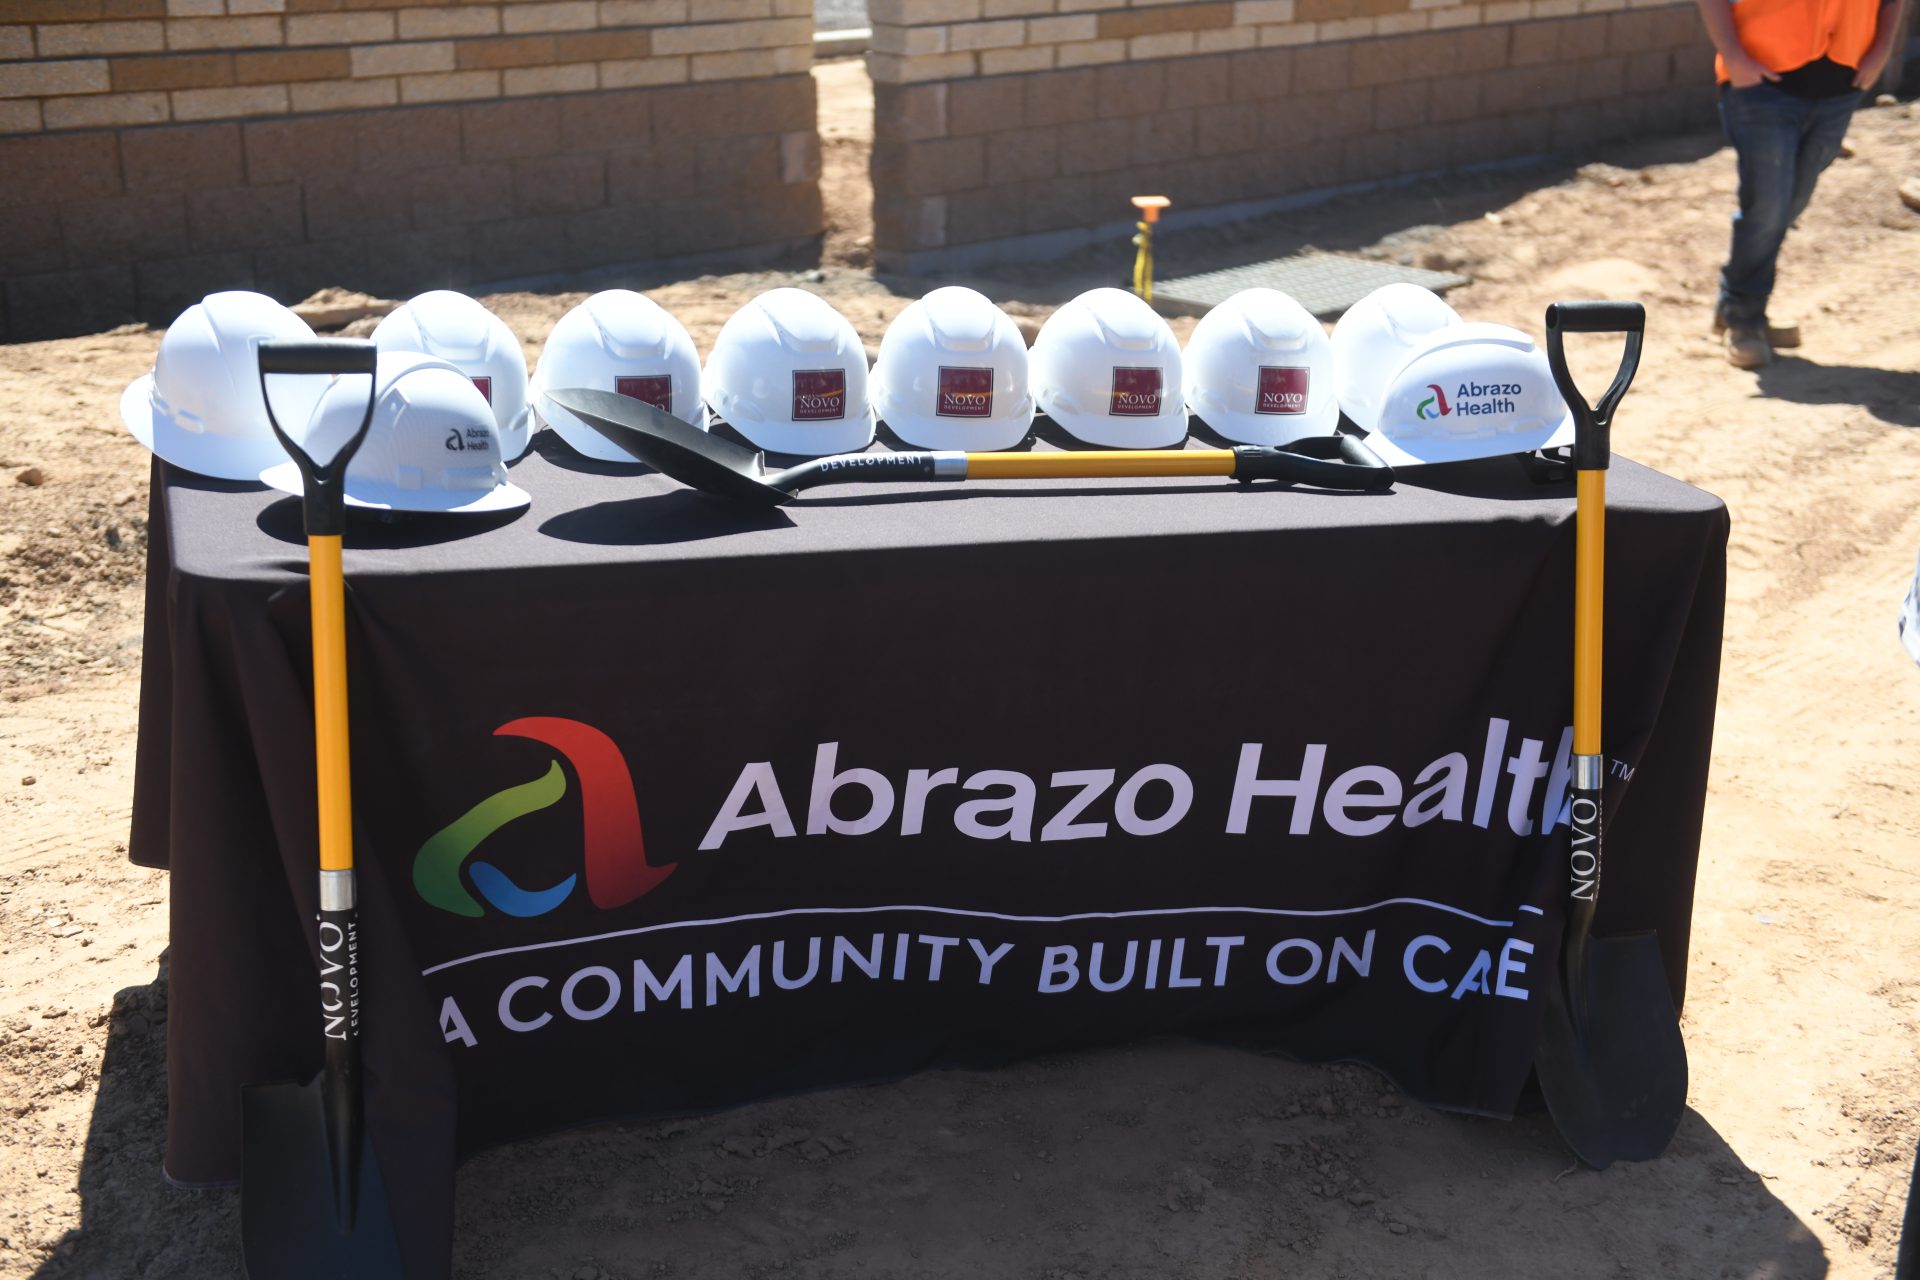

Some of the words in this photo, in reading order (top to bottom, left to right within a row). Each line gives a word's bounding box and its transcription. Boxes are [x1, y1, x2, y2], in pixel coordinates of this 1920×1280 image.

[1263, 392, 1303, 404] NOVO
[1457, 381, 1522, 398] Abrazo
[800, 397, 840, 408] NOVO
[944, 393, 986, 406] NOVO
[1118, 394, 1156, 405] NOVO
[1456, 398, 1515, 416] Health
[821, 455, 922, 472] DEVELOPMENT
[697, 741, 1195, 851] Abrazo
[1609, 758, 1636, 782] TM
[1570, 798, 1598, 902] NOVO
[319, 921, 347, 1041] NOVO
[348, 922, 359, 1037] EVELOPMENT
[439, 995, 479, 1048] A
[498, 932, 1016, 1032] COMMUNITY
[1037, 935, 1246, 994] BUILT
[1265, 929, 1376, 986] ON
[1403, 934, 1535, 1001] CAE
